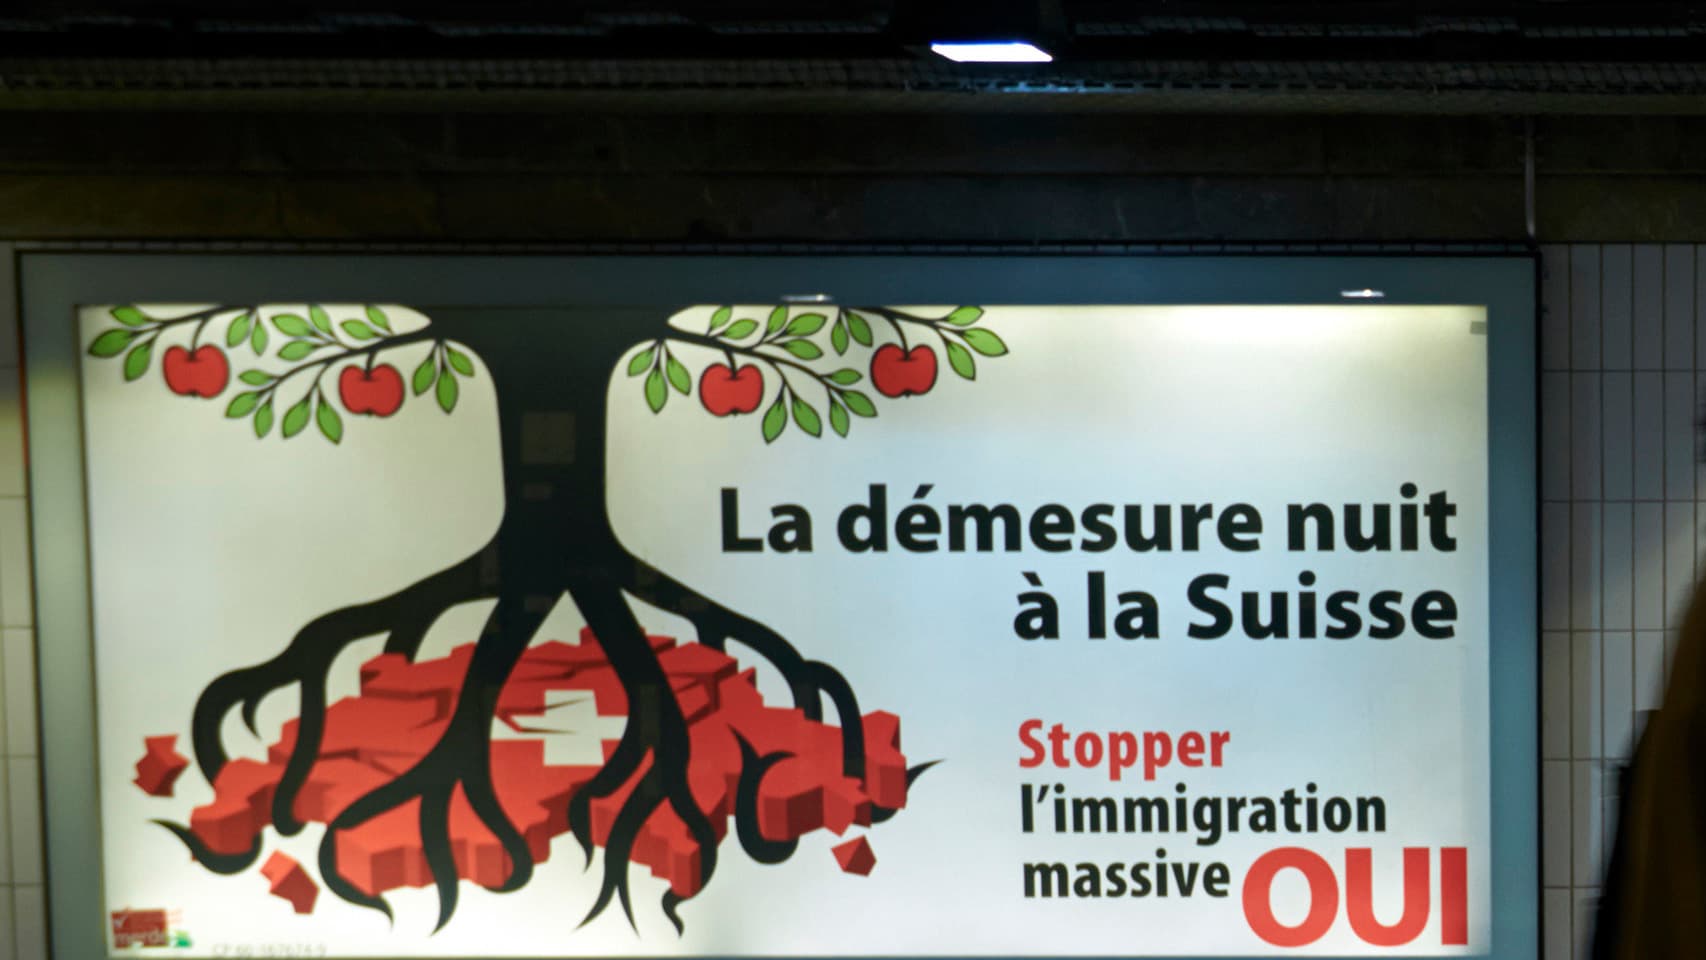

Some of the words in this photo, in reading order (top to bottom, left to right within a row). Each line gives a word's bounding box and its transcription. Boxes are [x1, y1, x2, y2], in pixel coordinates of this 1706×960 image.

[720, 487, 813, 554] La
[836, 483, 1263, 553] démesure
[1287, 482, 1457, 553] nuit
[1013, 571, 1060, 641] à
[1087, 571, 1160, 640] la
[1187, 570, 1458, 640] Suisse
[1018, 719, 1230, 781] Stopper
[1022, 846, 1230, 898] massive
[1241, 846, 1468, 948] OUI
